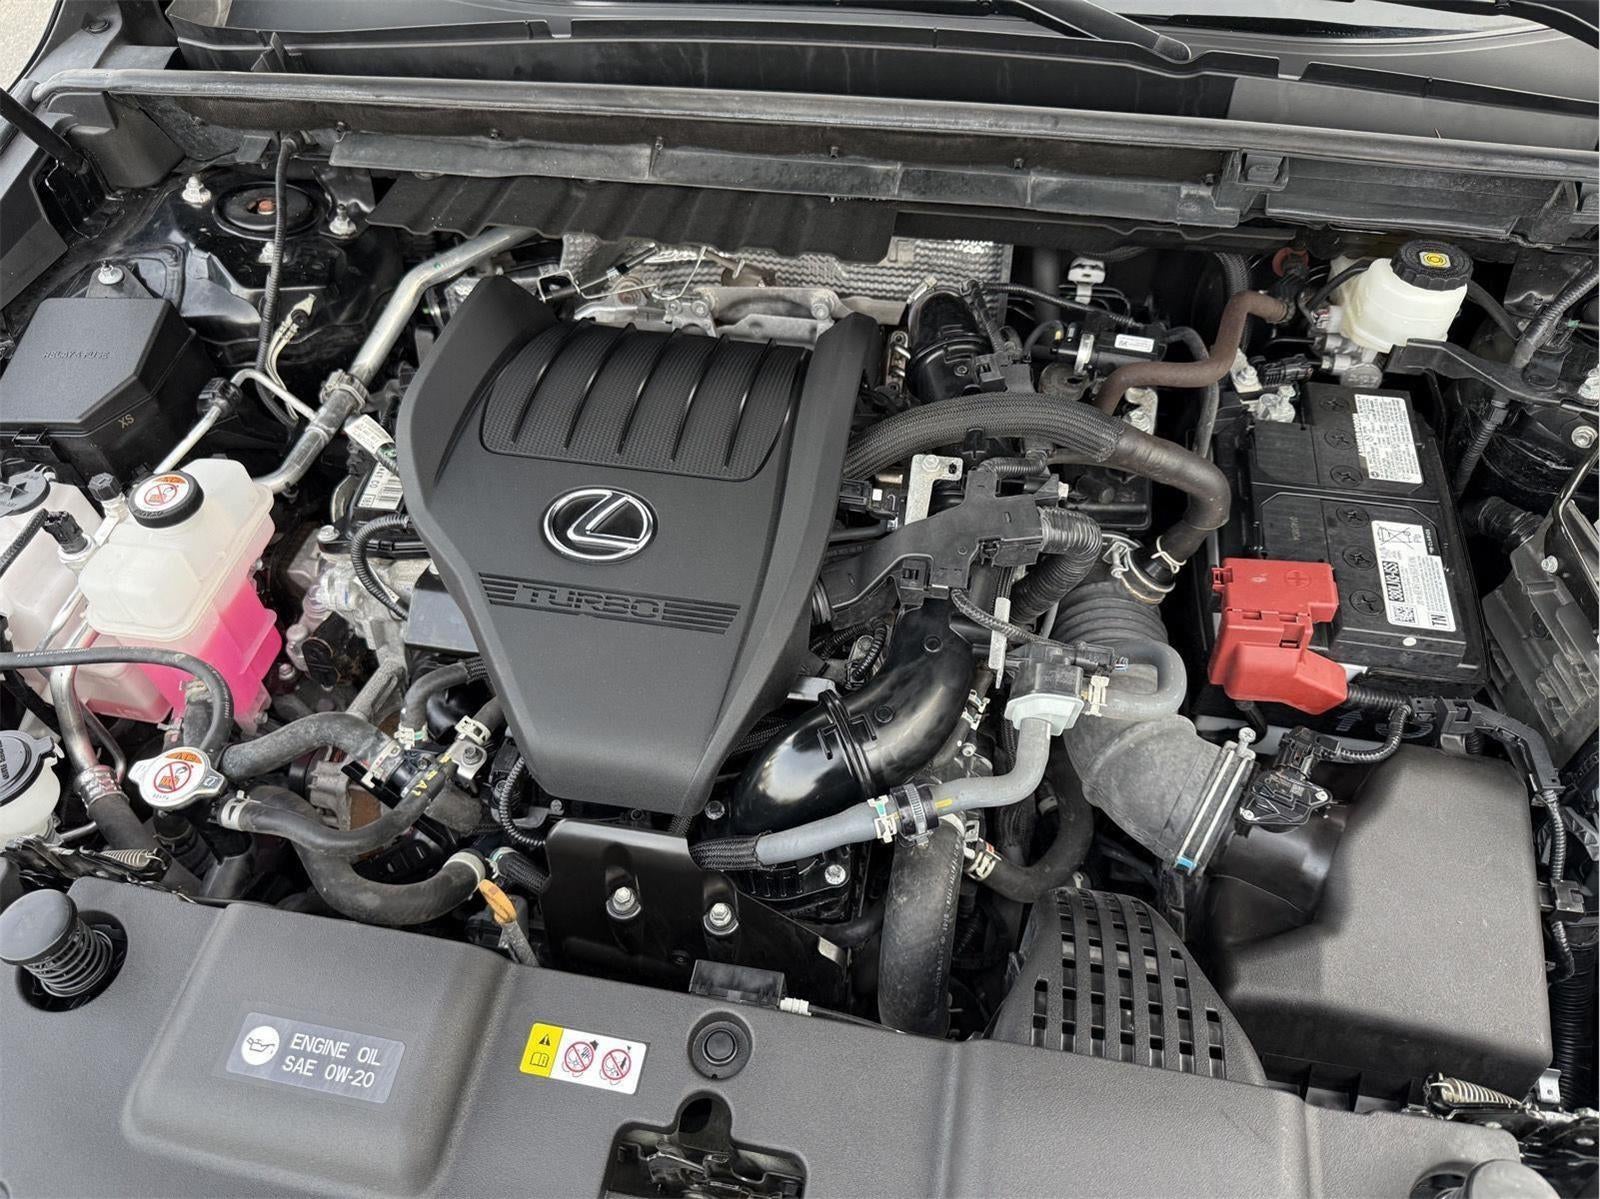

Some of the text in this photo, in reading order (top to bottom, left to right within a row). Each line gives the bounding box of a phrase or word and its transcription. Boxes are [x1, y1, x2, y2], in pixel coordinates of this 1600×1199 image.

[118, 414, 135, 429] XS
[520, 584, 661, 618] TURBO
[1431, 614, 1448, 627] TN
[290, 1032, 381, 1066] ENGINE OIL
[282, 1055, 375, 1088] SAE 0W-20
